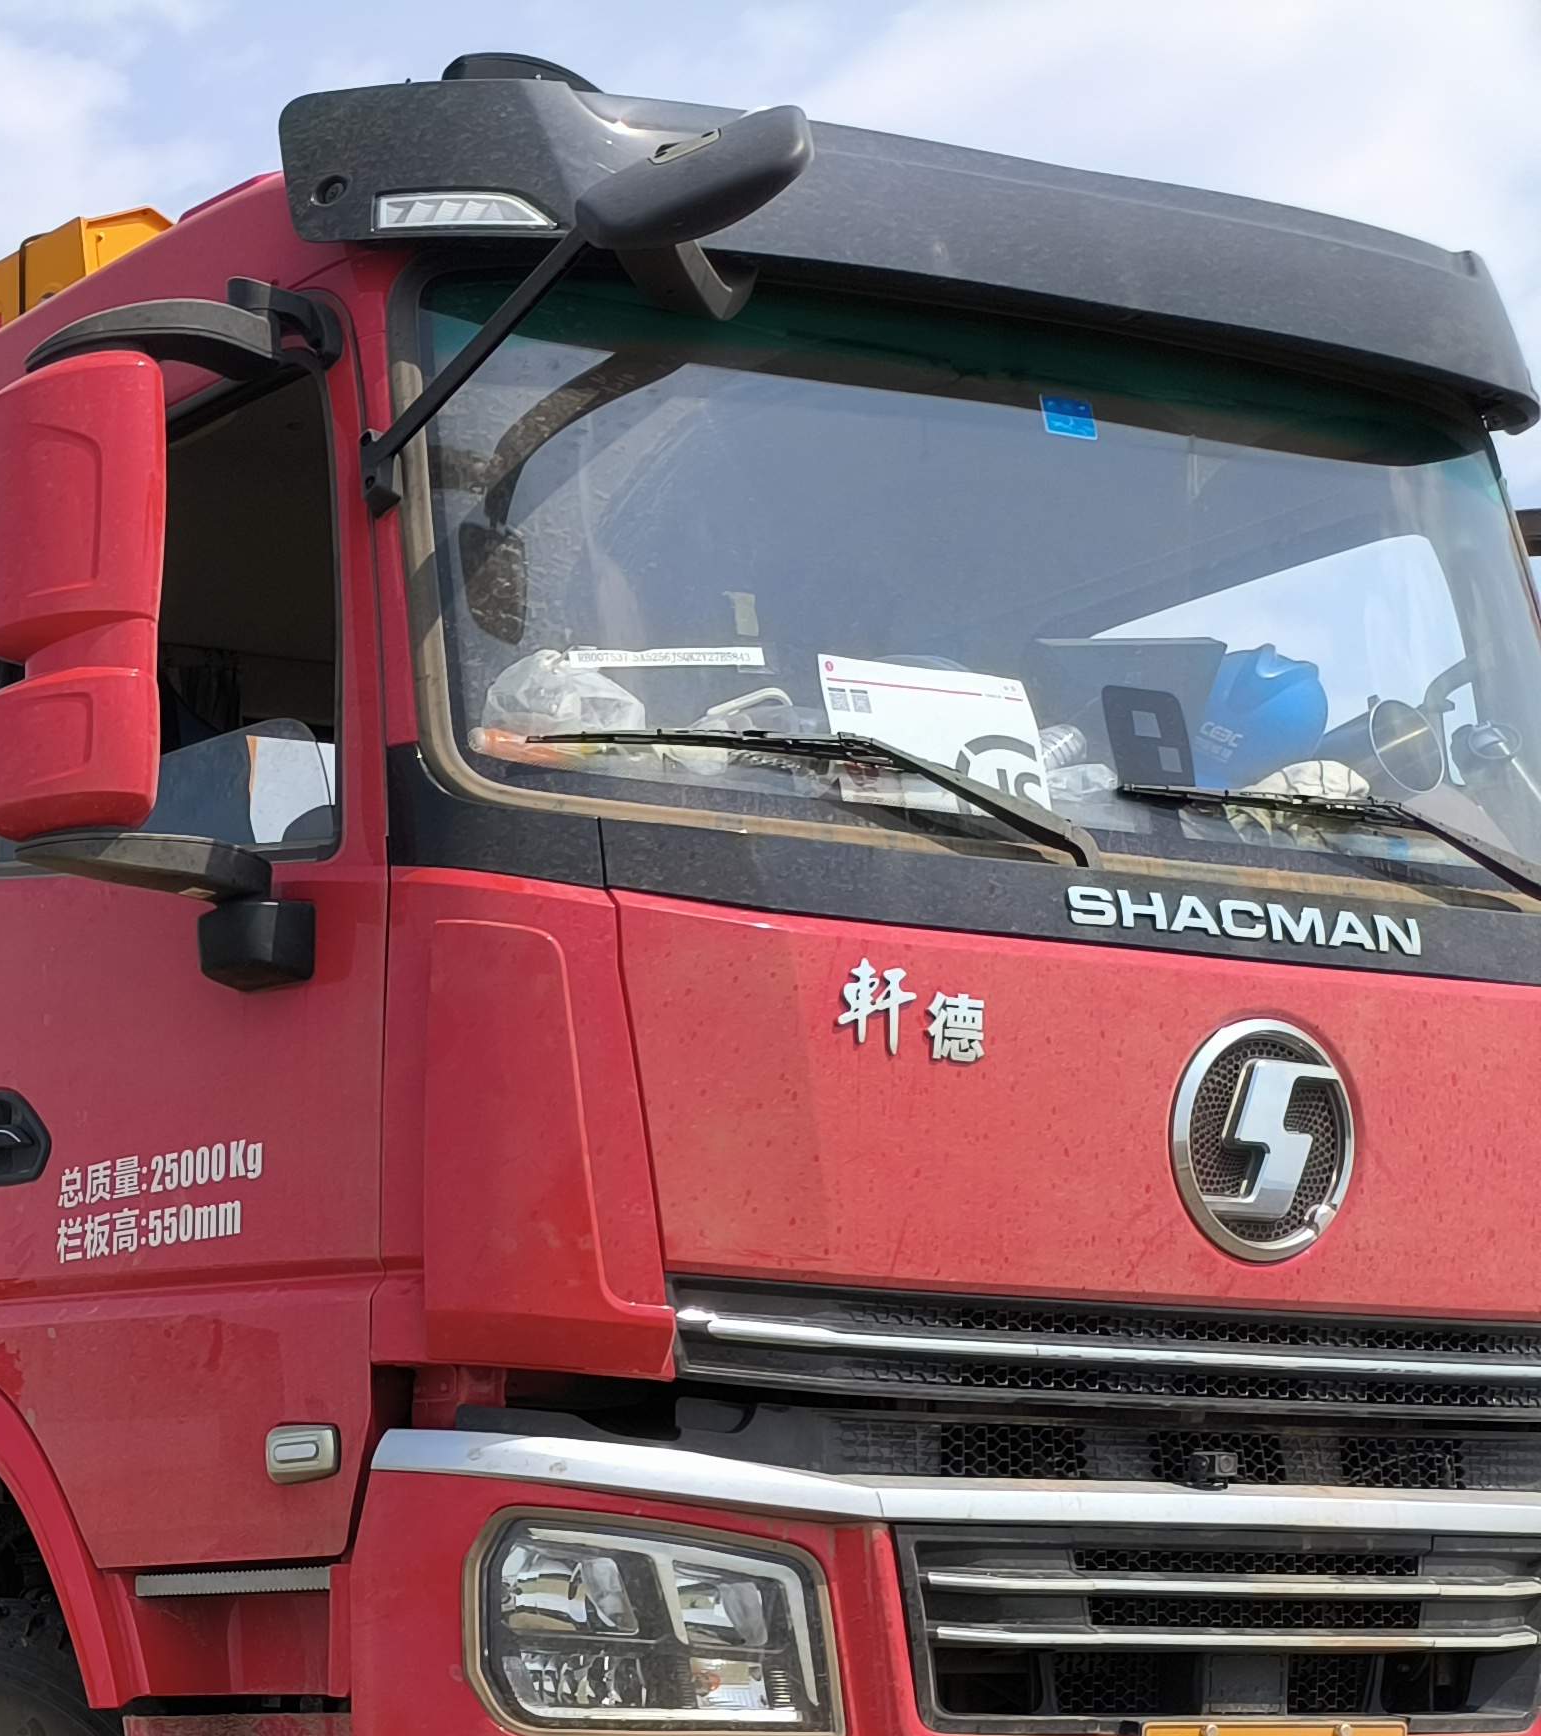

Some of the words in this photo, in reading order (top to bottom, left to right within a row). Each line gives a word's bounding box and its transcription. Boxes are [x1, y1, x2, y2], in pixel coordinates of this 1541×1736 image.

[1067, 885, 1422, 956] SHACMAN
[56, 1200, 241, 1264] 栏板高:550mm
